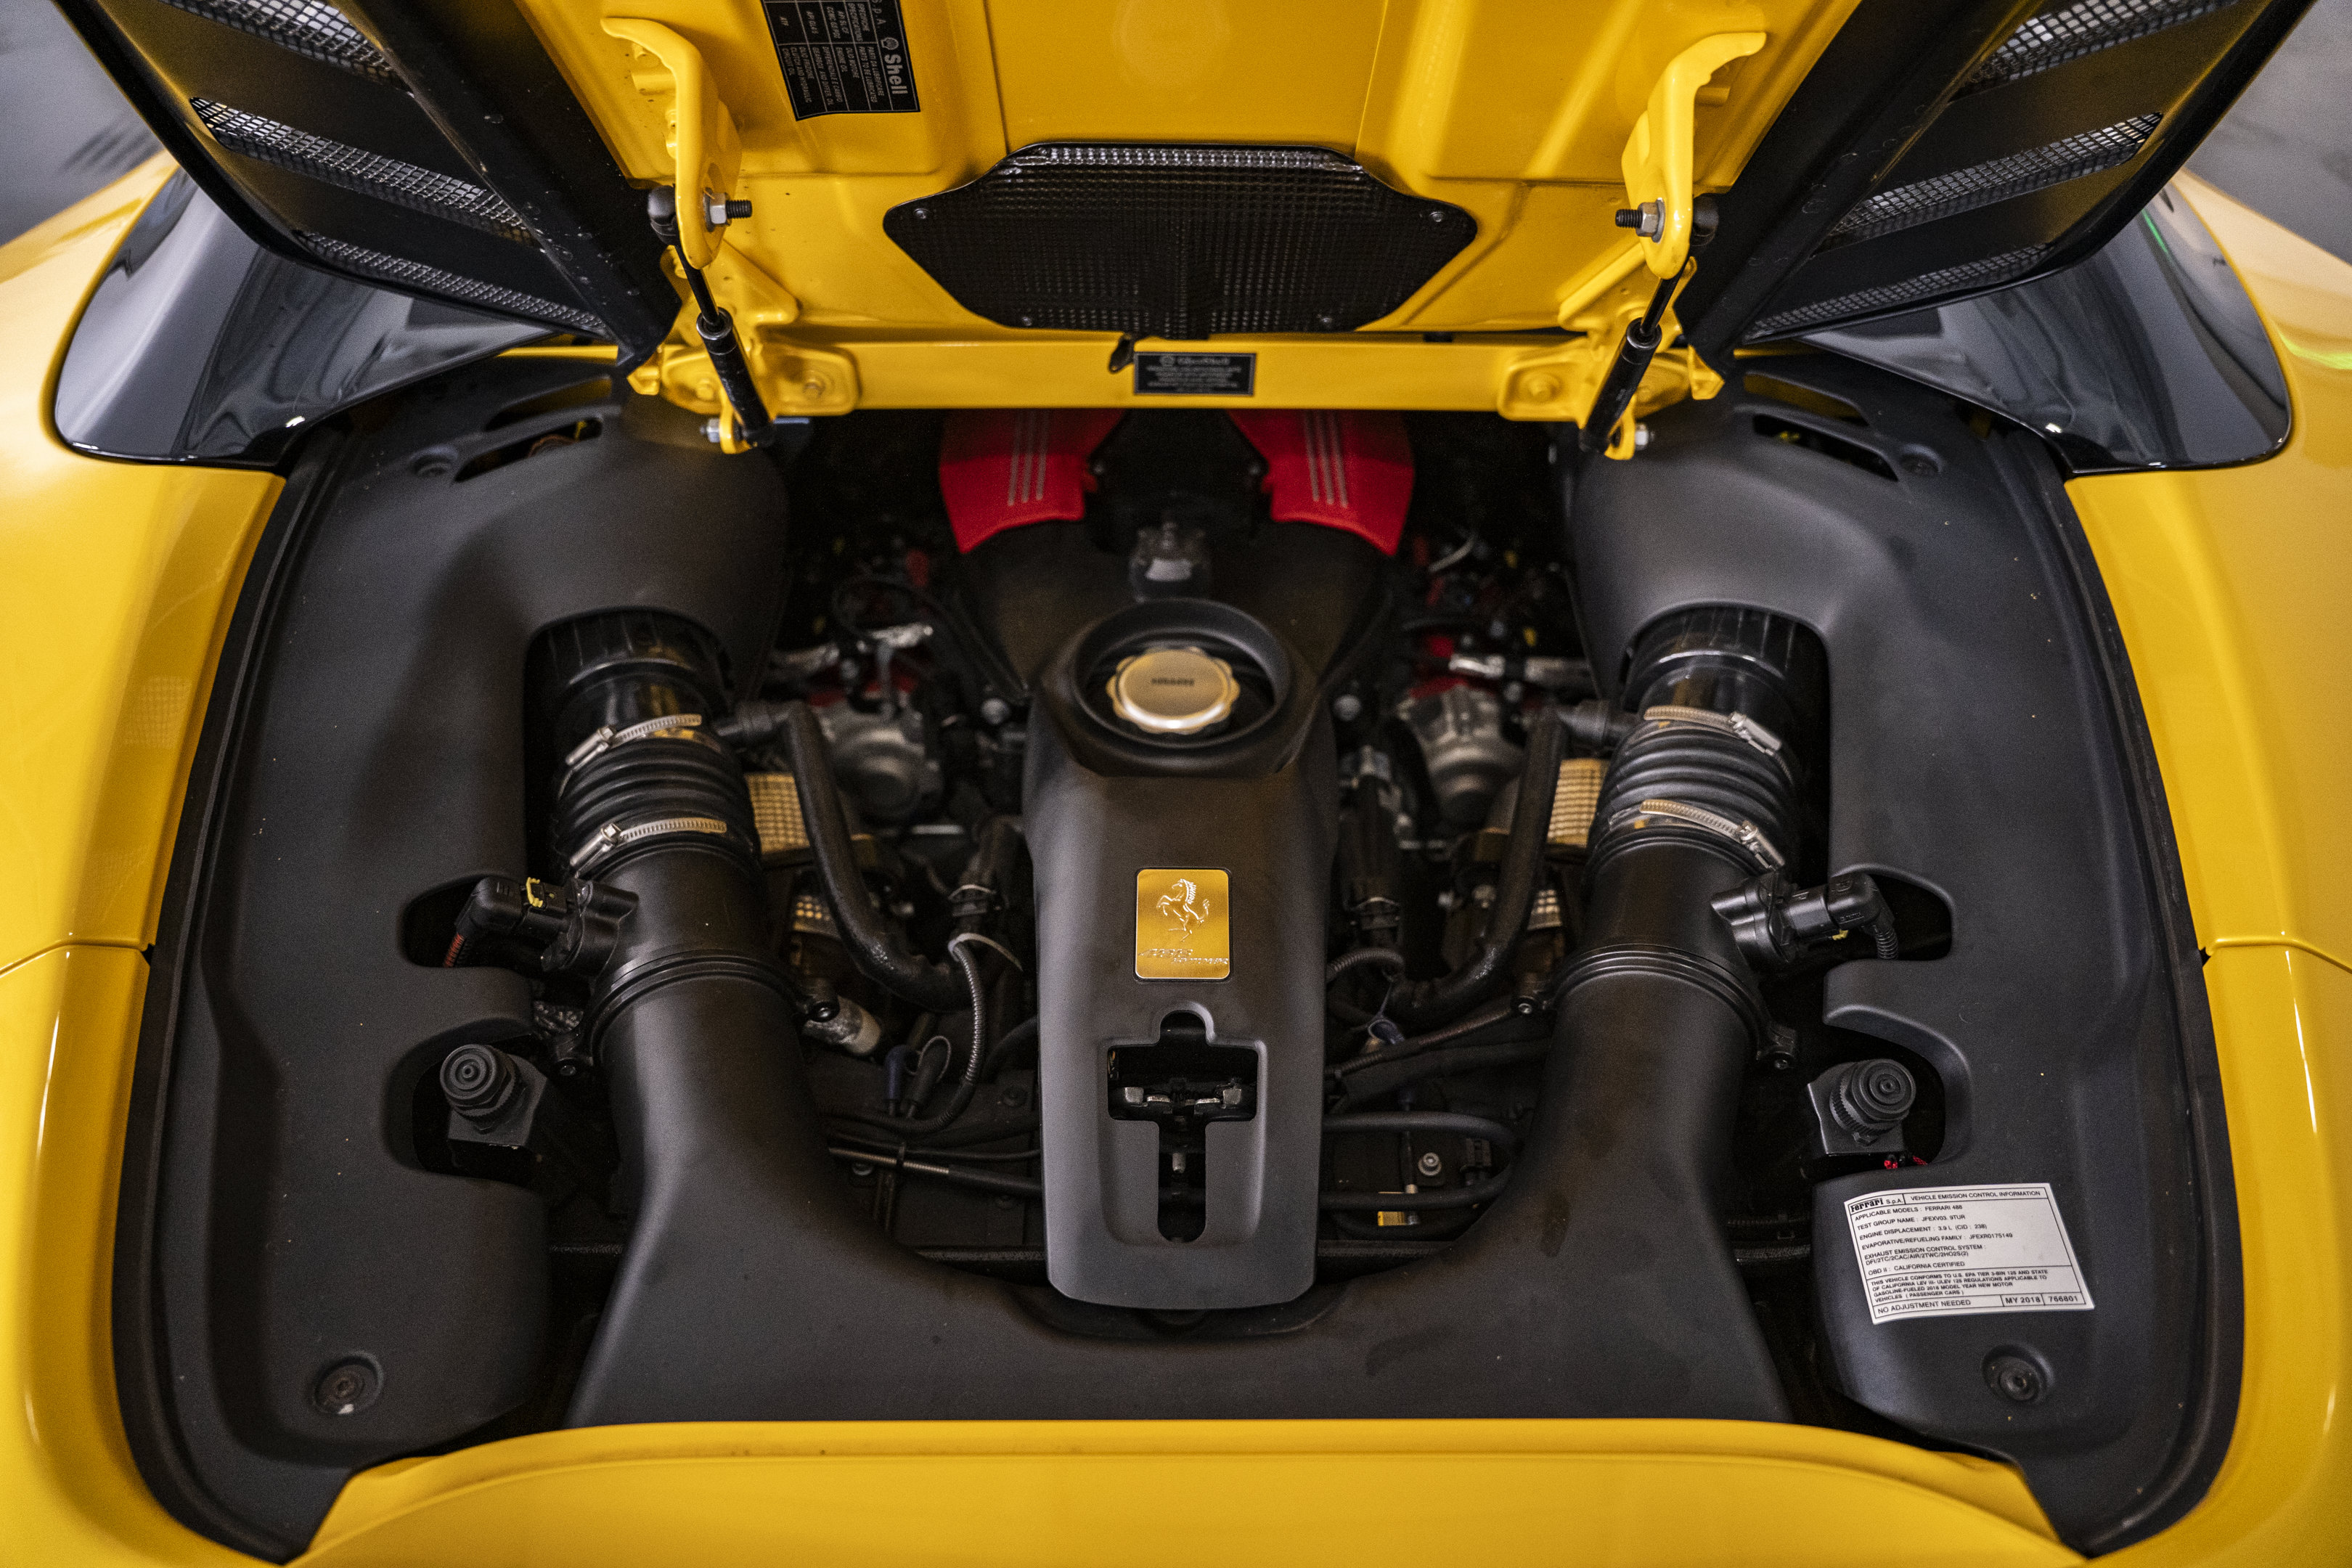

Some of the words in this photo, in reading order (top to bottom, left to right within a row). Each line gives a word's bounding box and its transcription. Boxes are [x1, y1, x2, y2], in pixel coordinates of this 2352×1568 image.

[848, 3, 863, 41] SPECIFICATIONS
[857, 4, 870, 31] SPECIFICHE
[812, 47, 824, 69] GEARBOX
[836, 47, 846, 64] ENGINE
[791, 47, 801, 65] CLUTCH
[801, 77, 812, 103] HYDRAULIC
[804, 59, 814, 79] FRIZIONE
[849, 60, 859, 78] MOTORE
[884, 54, 908, 94] Shell
[865, 76, 878, 102] LUBRICATED
[872, 68, 884, 96] LUBRIFICARE
[833, 86, 843, 102] CAMBIO
[1850, 1198, 1884, 1212] Ferrari
[1855, 1209, 1891, 1221] APPLICABLE
[1860, 1230, 1883, 1240] ENGINE
[1885, 1227, 1931, 1236] DISPLACEMENT
[1862, 1236, 1940, 1250] EVAPORATIVE/REFUELING
[1865, 1249, 1892, 1259] EXHAUST
[1874, 1285, 1924, 1297] GASOLINE-FUELED
[1875, 1294, 1902, 1303] VEHICLES
[1891, 1302, 1939, 1311] ADJUSTMENT
